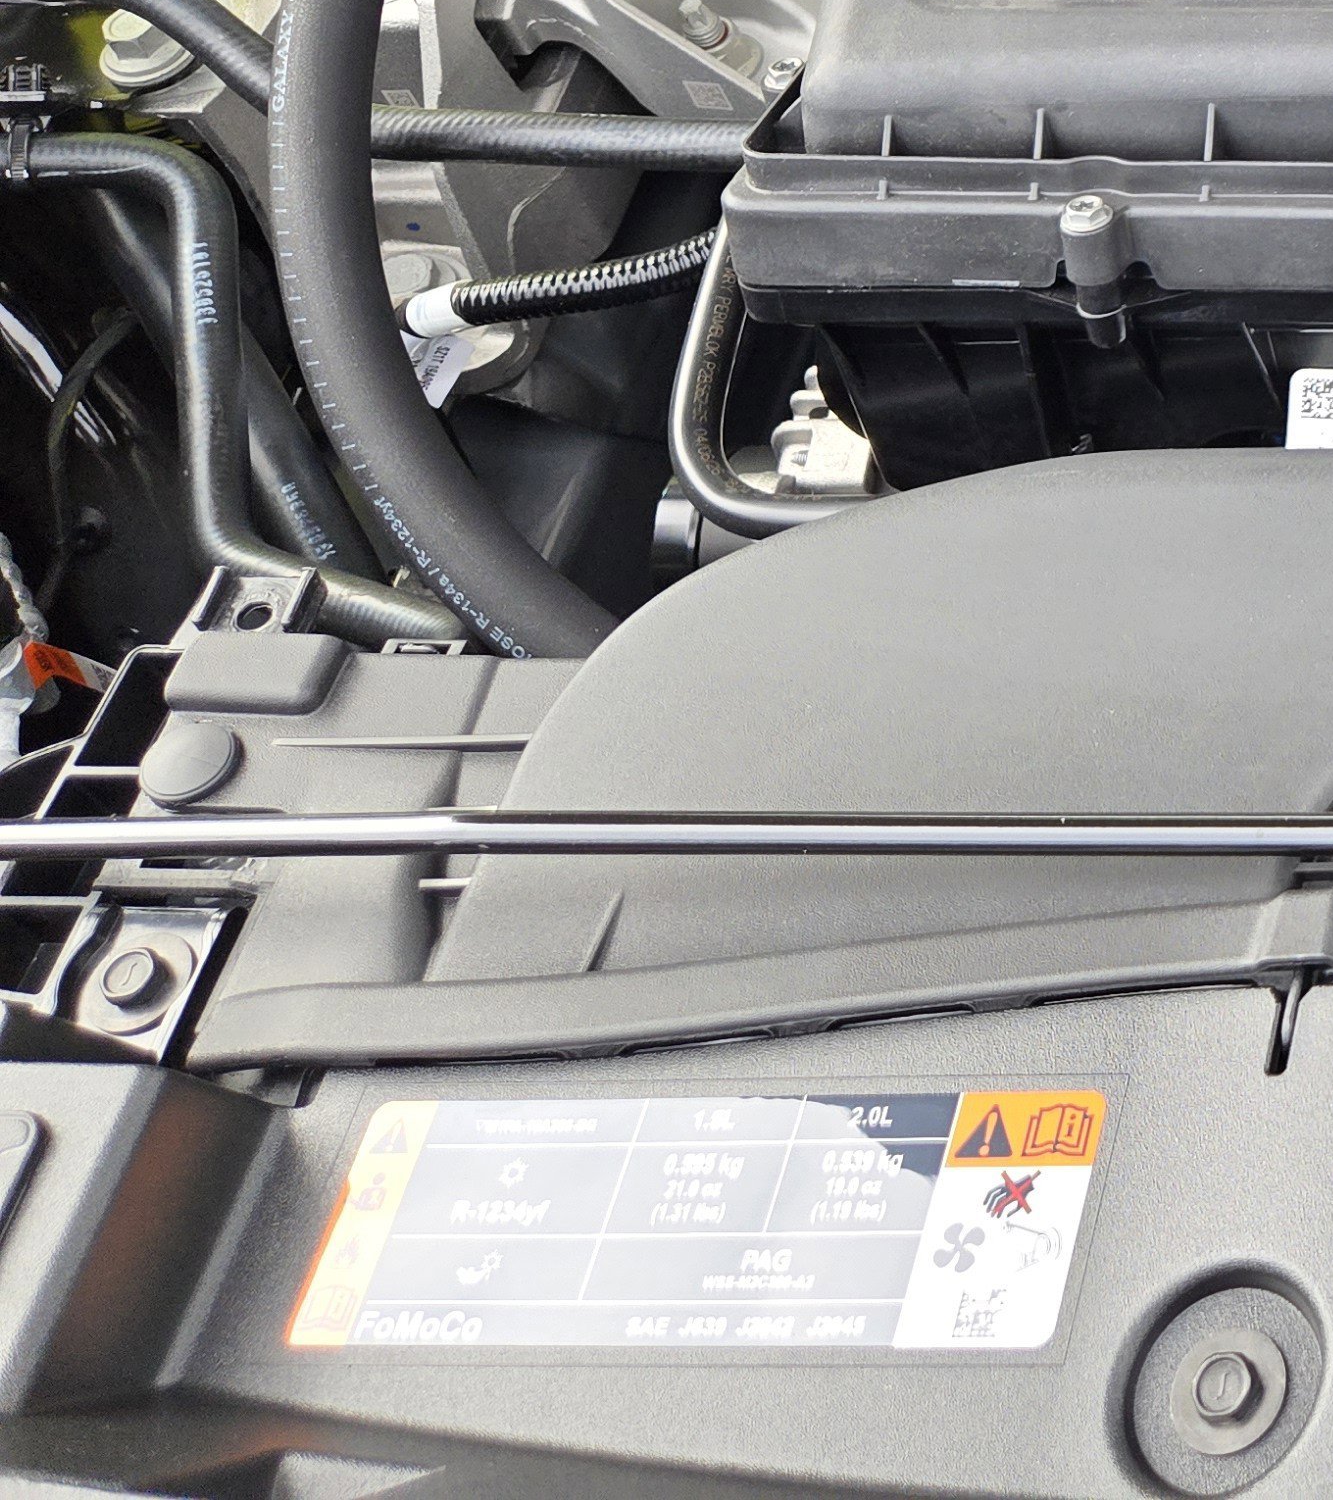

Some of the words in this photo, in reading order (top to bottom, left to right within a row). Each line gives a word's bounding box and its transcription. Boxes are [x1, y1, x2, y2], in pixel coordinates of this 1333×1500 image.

[272, 9, 295, 113] GALAXY
[489, 625, 532, 660] OSE
[847, 1105, 893, 1128] 2.0L
[718, 1152, 745, 1180] kg
[876, 1150, 904, 1178] kg
[739, 1249, 792, 1273] PAG
[354, 1310, 483, 1340] FoMoCo
[624, 1315, 670, 1338] SAE
